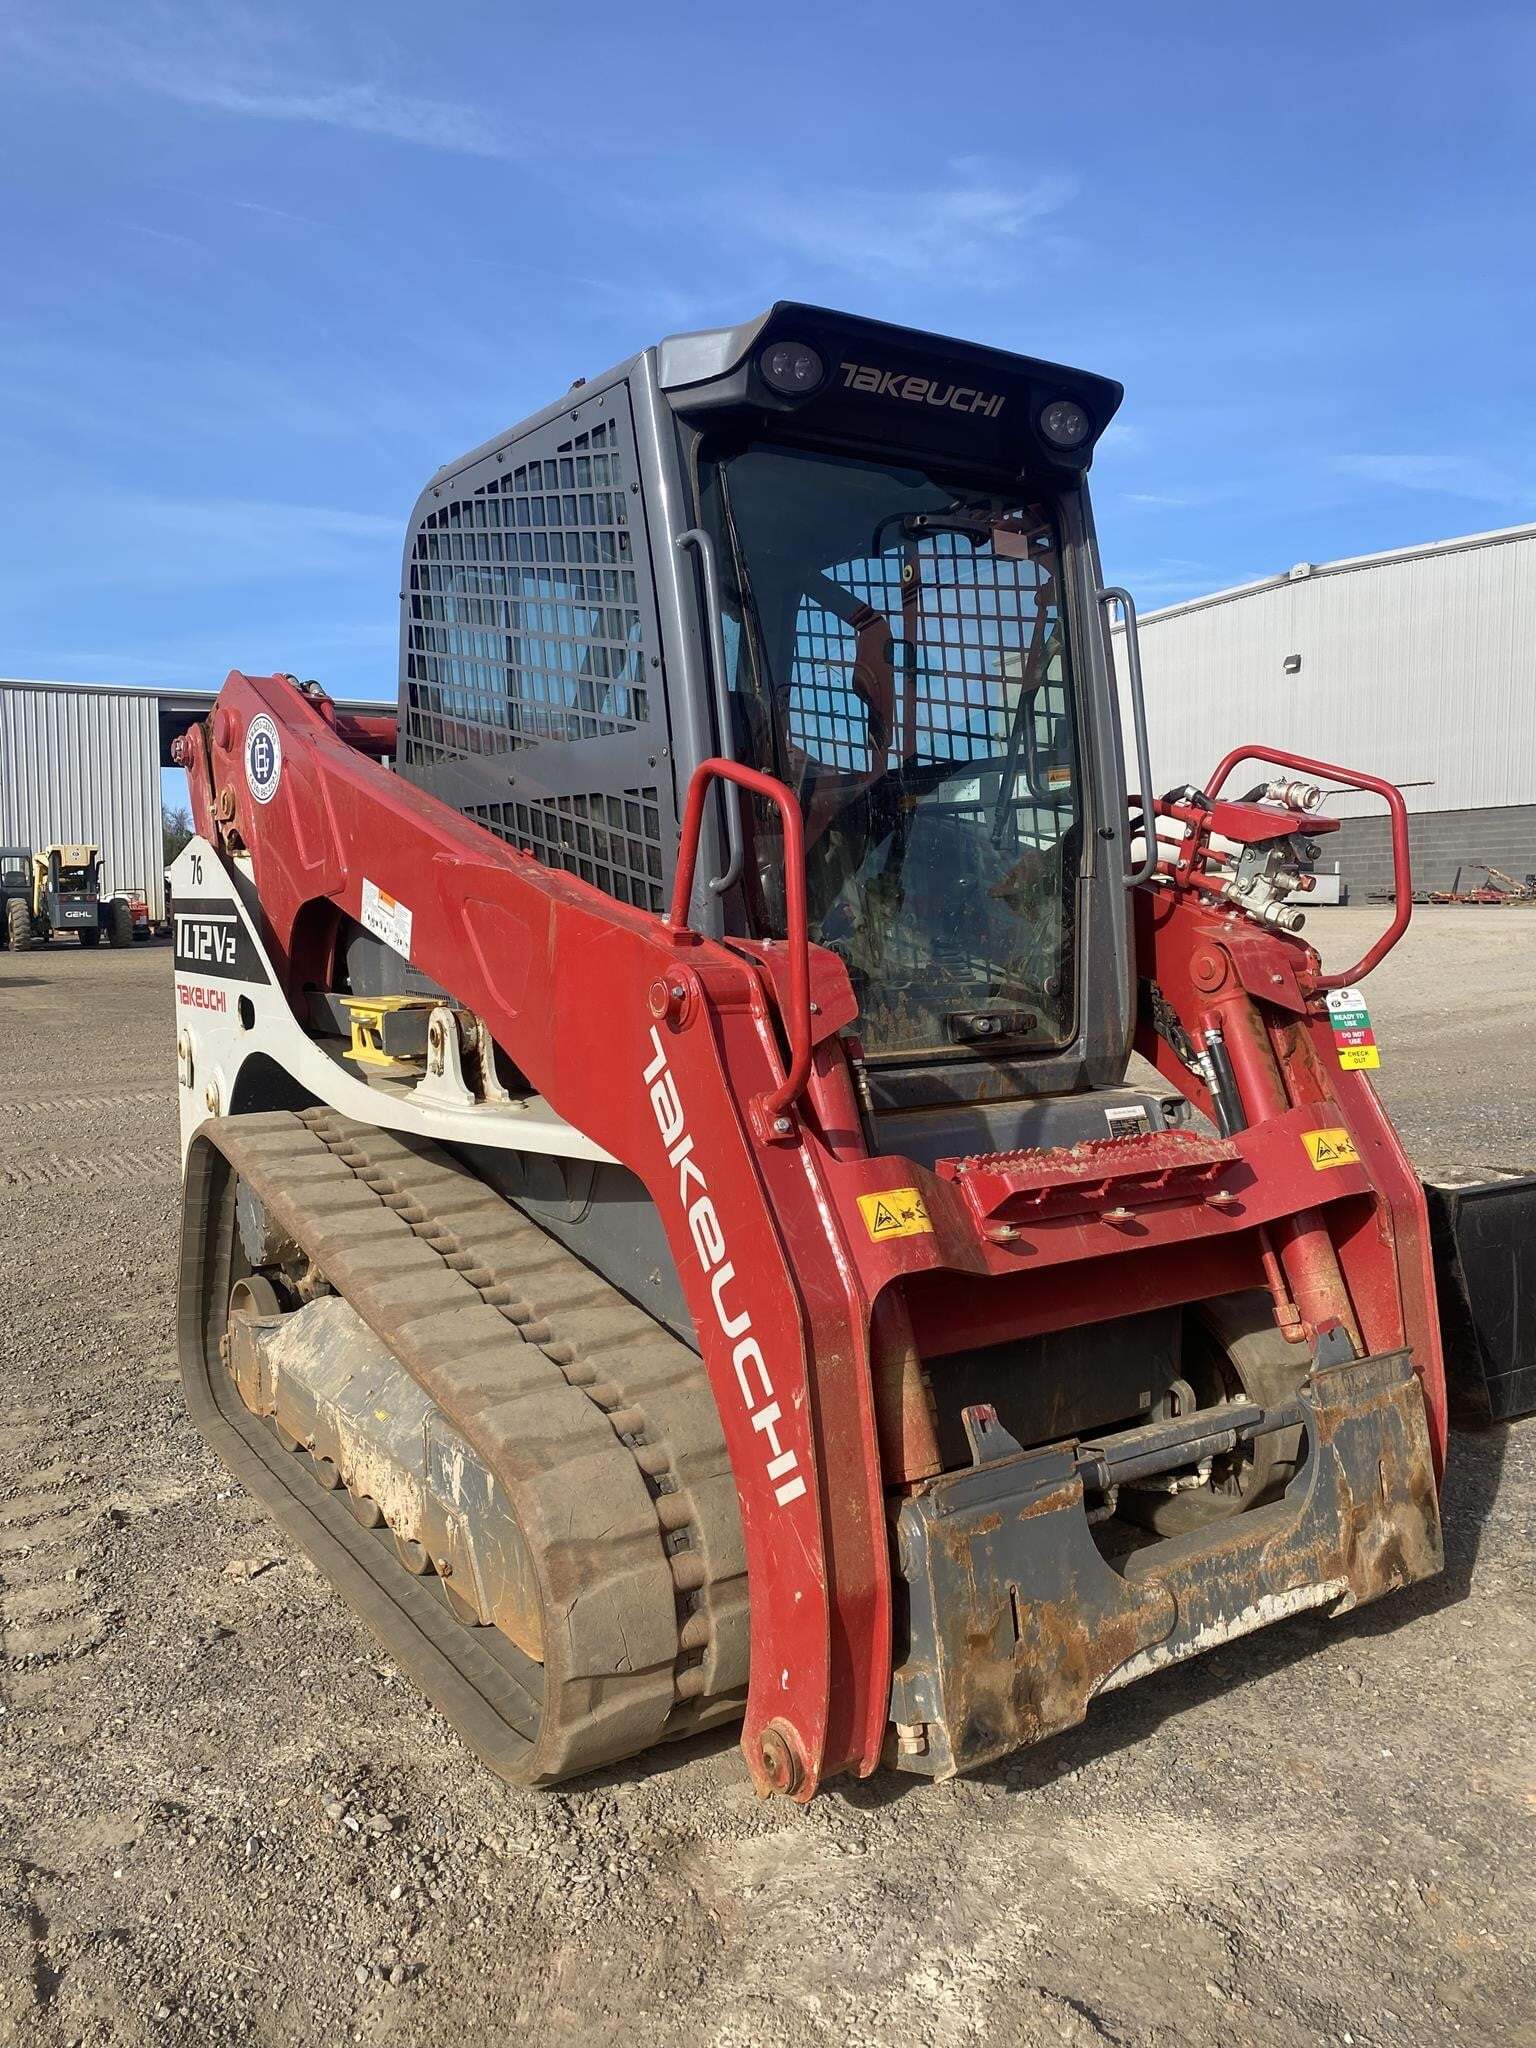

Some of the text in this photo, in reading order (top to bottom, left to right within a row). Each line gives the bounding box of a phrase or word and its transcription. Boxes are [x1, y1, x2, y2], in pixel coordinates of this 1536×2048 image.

[190, 854, 203, 885] 76
[1334, 1012, 1365, 1021] READY TO
[1341, 1030, 1365, 1039] DO NOT
